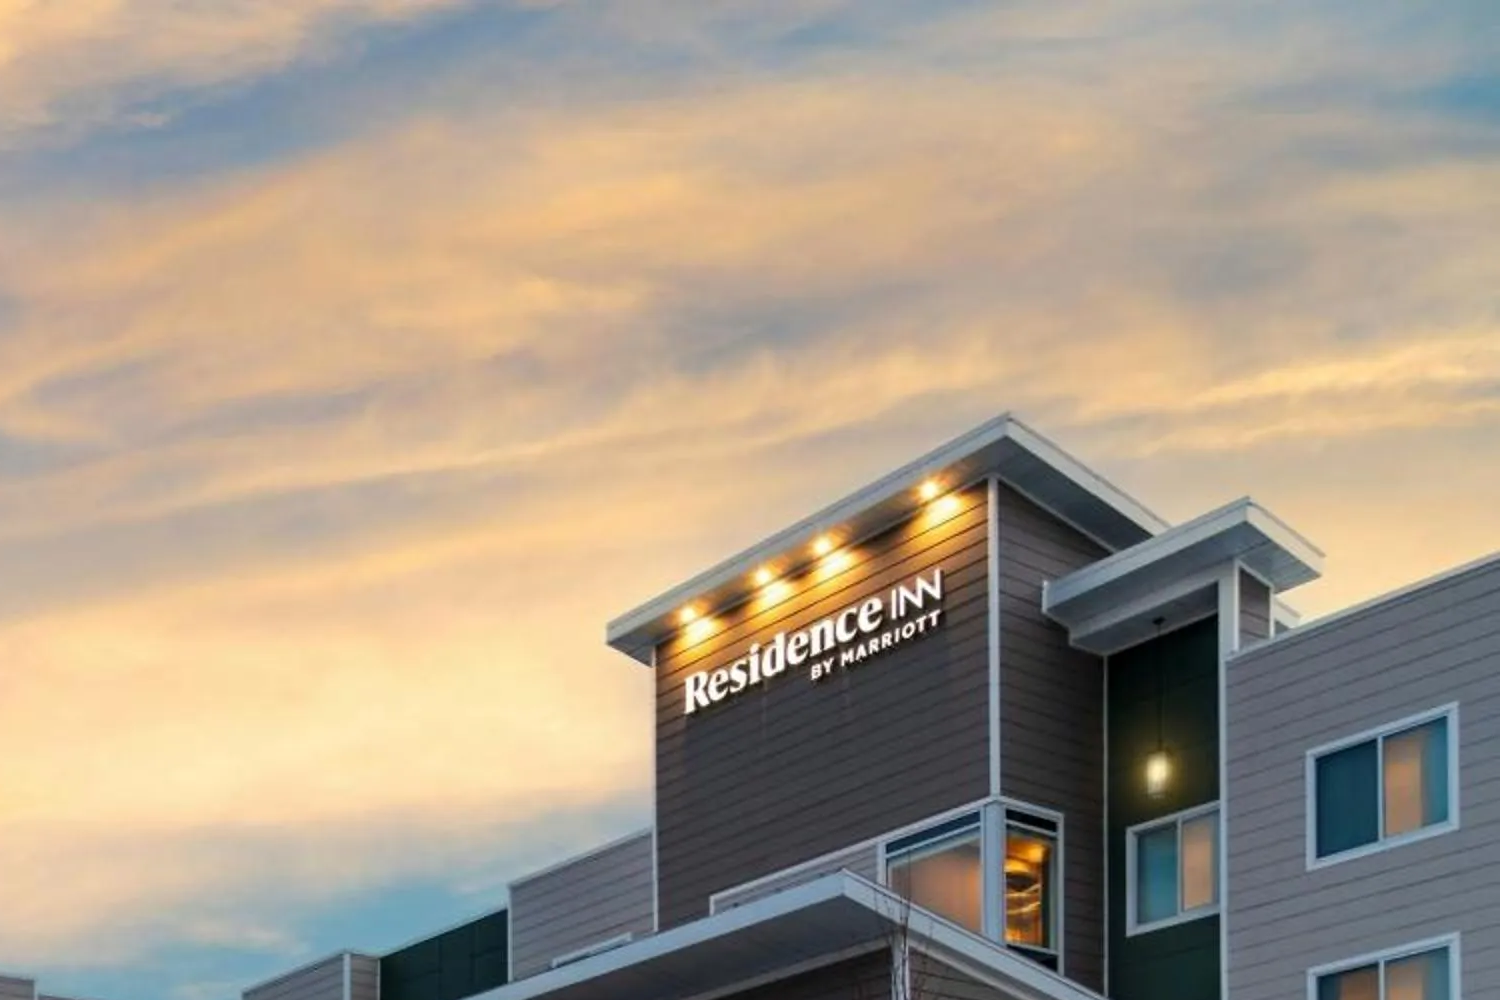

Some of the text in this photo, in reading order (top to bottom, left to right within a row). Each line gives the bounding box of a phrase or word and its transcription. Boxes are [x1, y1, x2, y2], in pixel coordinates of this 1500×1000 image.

[684, 568, 943, 714] Residence INN
[811, 609, 941, 681] BY MARRIOTT
